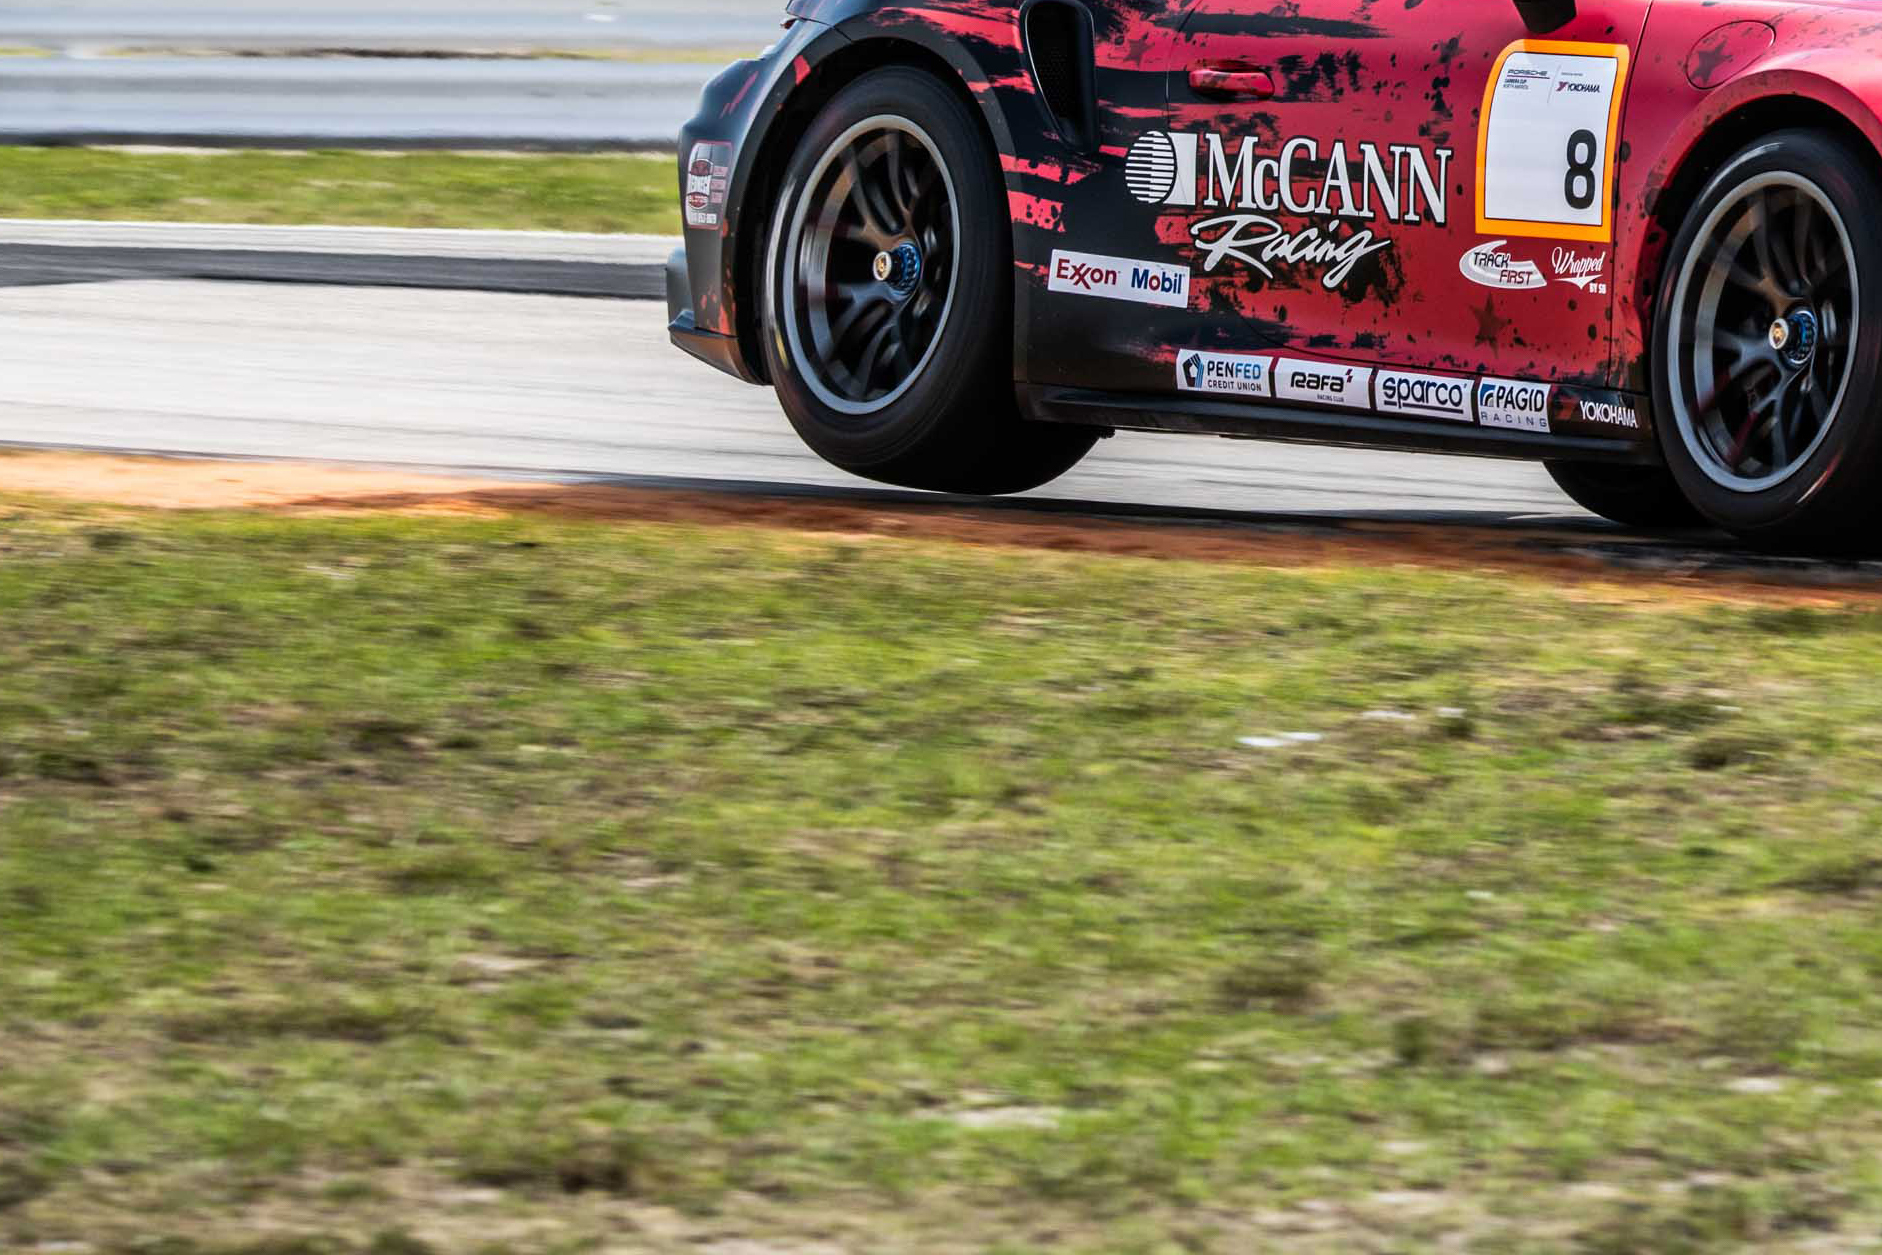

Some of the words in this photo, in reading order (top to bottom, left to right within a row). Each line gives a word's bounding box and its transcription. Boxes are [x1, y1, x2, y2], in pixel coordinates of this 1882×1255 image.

[1567, 82, 1601, 93] YOKOHAMA
[1205, 132, 1452, 224] McCANN
[1564, 128, 1598, 210] 8
[1190, 214, 1391, 289] Racing
[1472, 252, 1510, 269] TRACK
[1551, 246, 1607, 278] Wrapped
[1056, 257, 1118, 290] Exxon
[1131, 267, 1184, 295] Mobil
[1499, 269, 1534, 285] FIRST
[1207, 359, 1262, 380] PENFED
[1207, 379, 1235, 390] CREDIT
[1237, 381, 1262, 392] UNION
[1382, 375, 1464, 409] sparco
[1496, 385, 1545, 412] PAGID
[1480, 410, 1548, 428] RACING
[1579, 400, 1639, 428] YOKOHAMA
